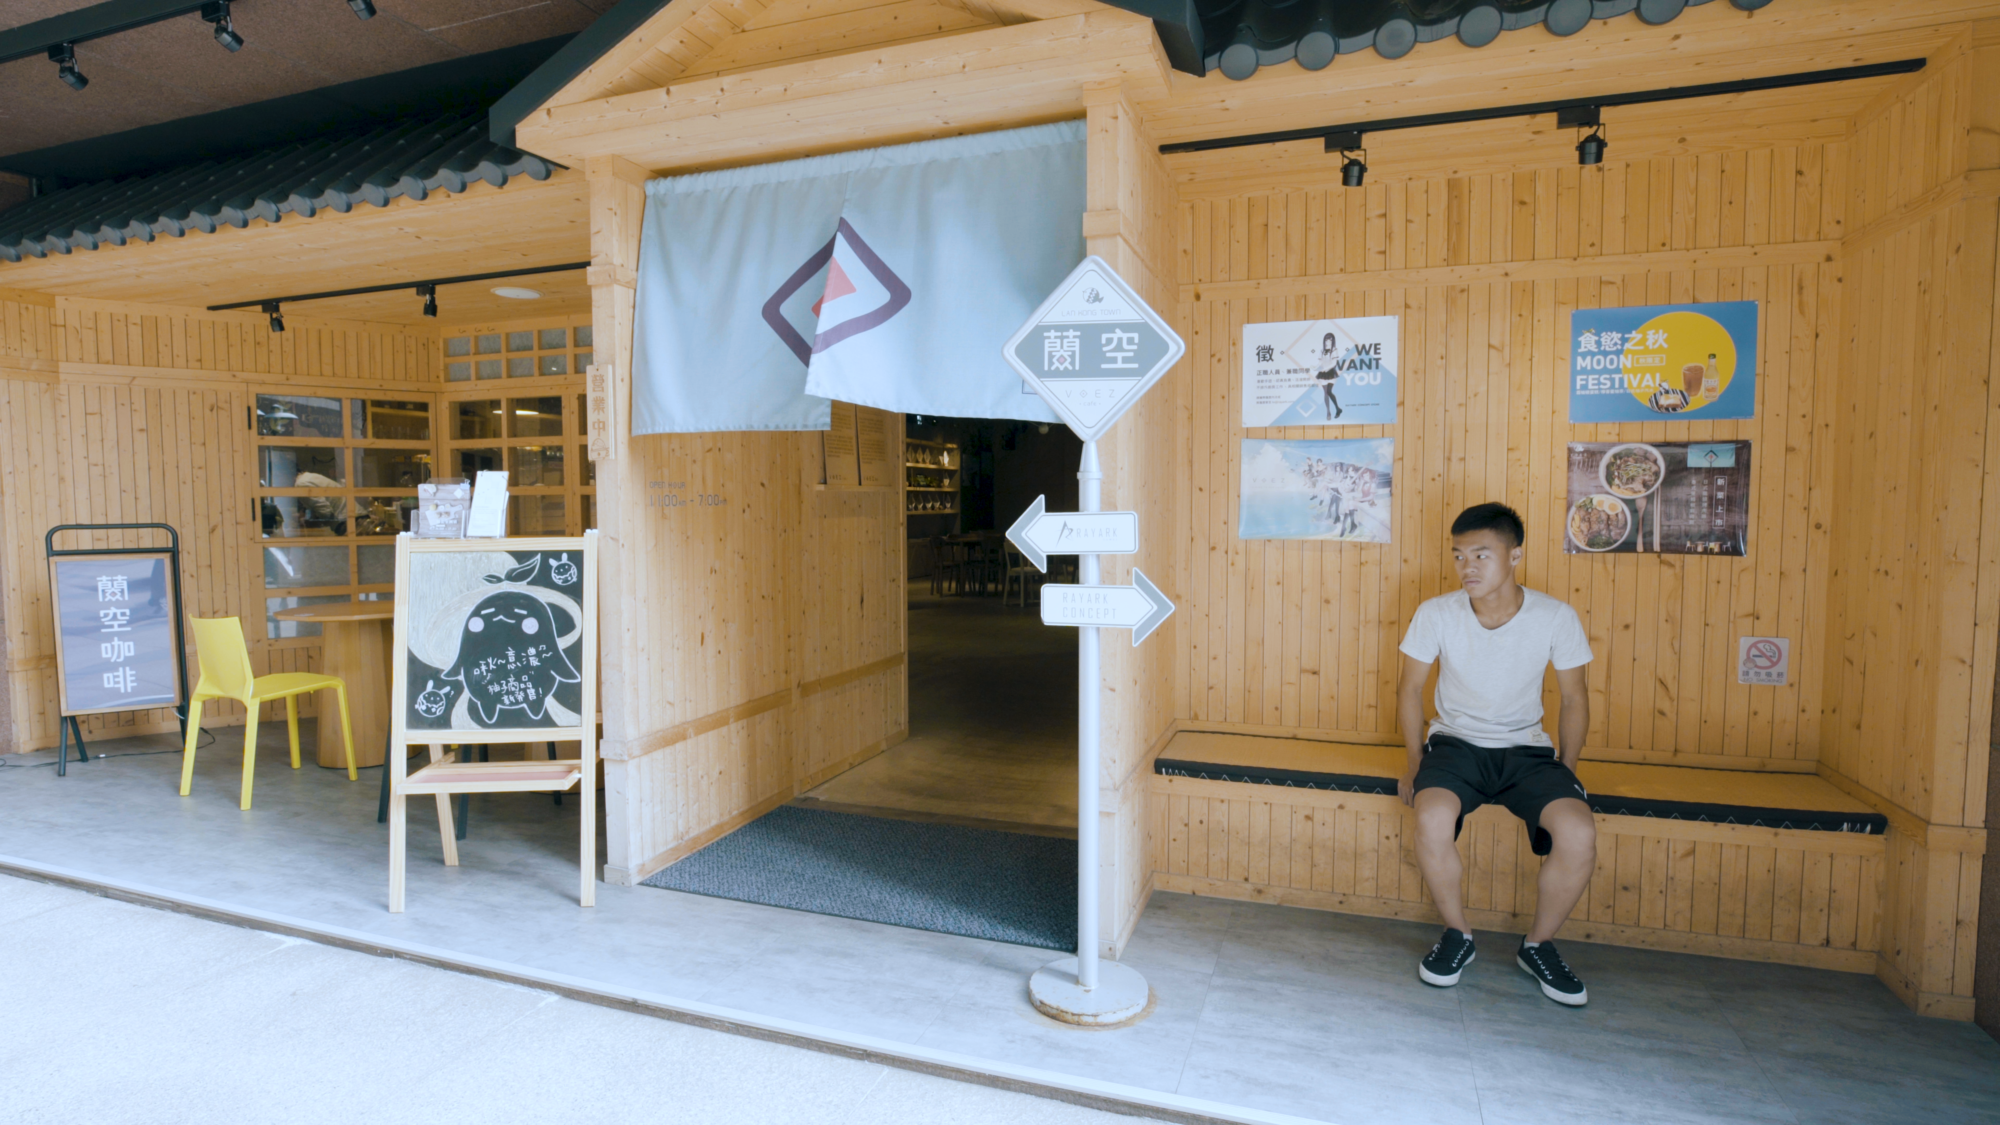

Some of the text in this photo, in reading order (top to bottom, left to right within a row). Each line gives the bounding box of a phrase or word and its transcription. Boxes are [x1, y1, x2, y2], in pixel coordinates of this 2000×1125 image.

[1100, 308, 1121, 316] TOWN
[1577, 329, 1668, 353] 食慾之秋
[1043, 328, 1139, 371] 蘭空
[1256, 344, 1275, 363] 徵
[1354, 342, 1382, 356] WE
[1576, 354, 1632, 371] MOON
[1342, 371, 1382, 386] YOU
[591, 373, 606, 437] 營業中
[649, 481, 686, 489] OPEN HOUR
[1076, 527, 1118, 539] RAYARK
[1062, 592, 1109, 605] RAYARK
[1062, 607, 1117, 619] CONCEPT
[96, 575, 138, 693] 蘭空咖啡
